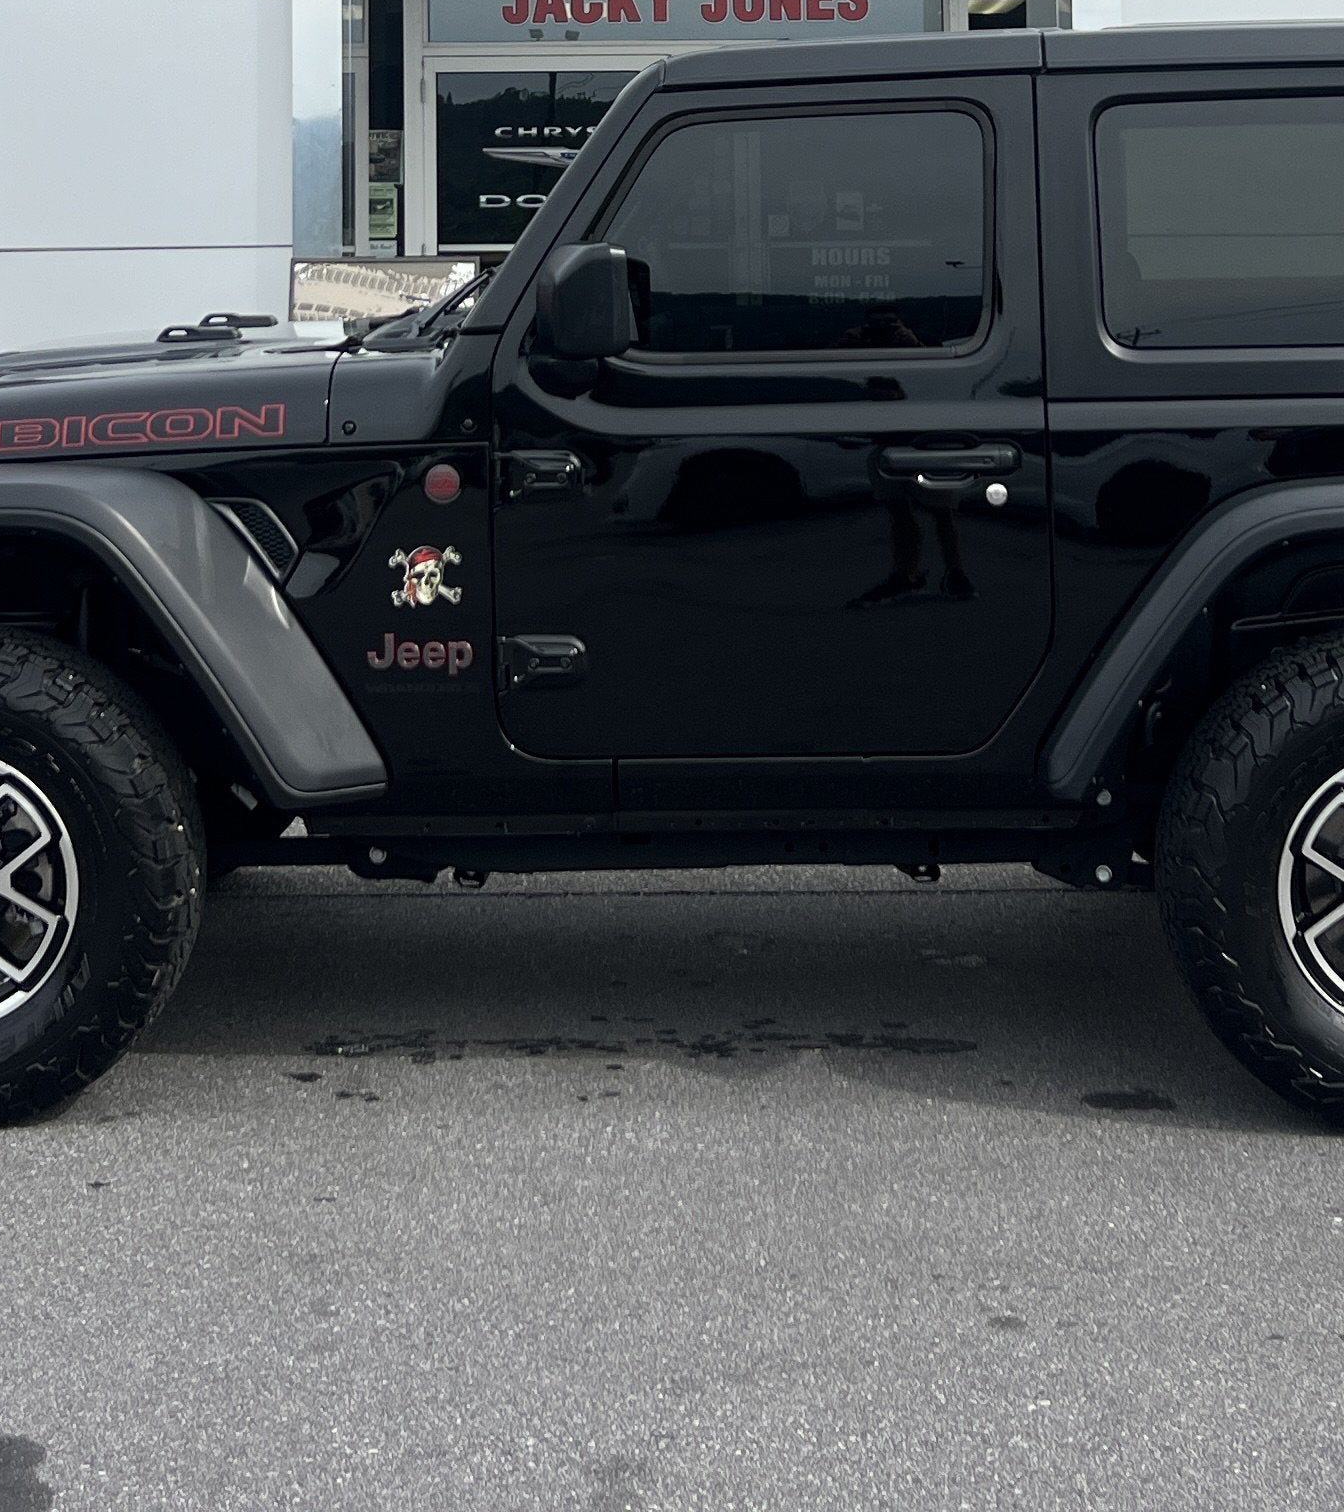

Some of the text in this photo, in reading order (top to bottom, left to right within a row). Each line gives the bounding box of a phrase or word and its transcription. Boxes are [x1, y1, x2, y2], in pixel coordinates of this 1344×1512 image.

[811, 247, 891, 266] HOURS
[813, 274, 852, 288] MON
[864, 274, 891, 288] FRI
[367, 632, 474, 676] Jeep
